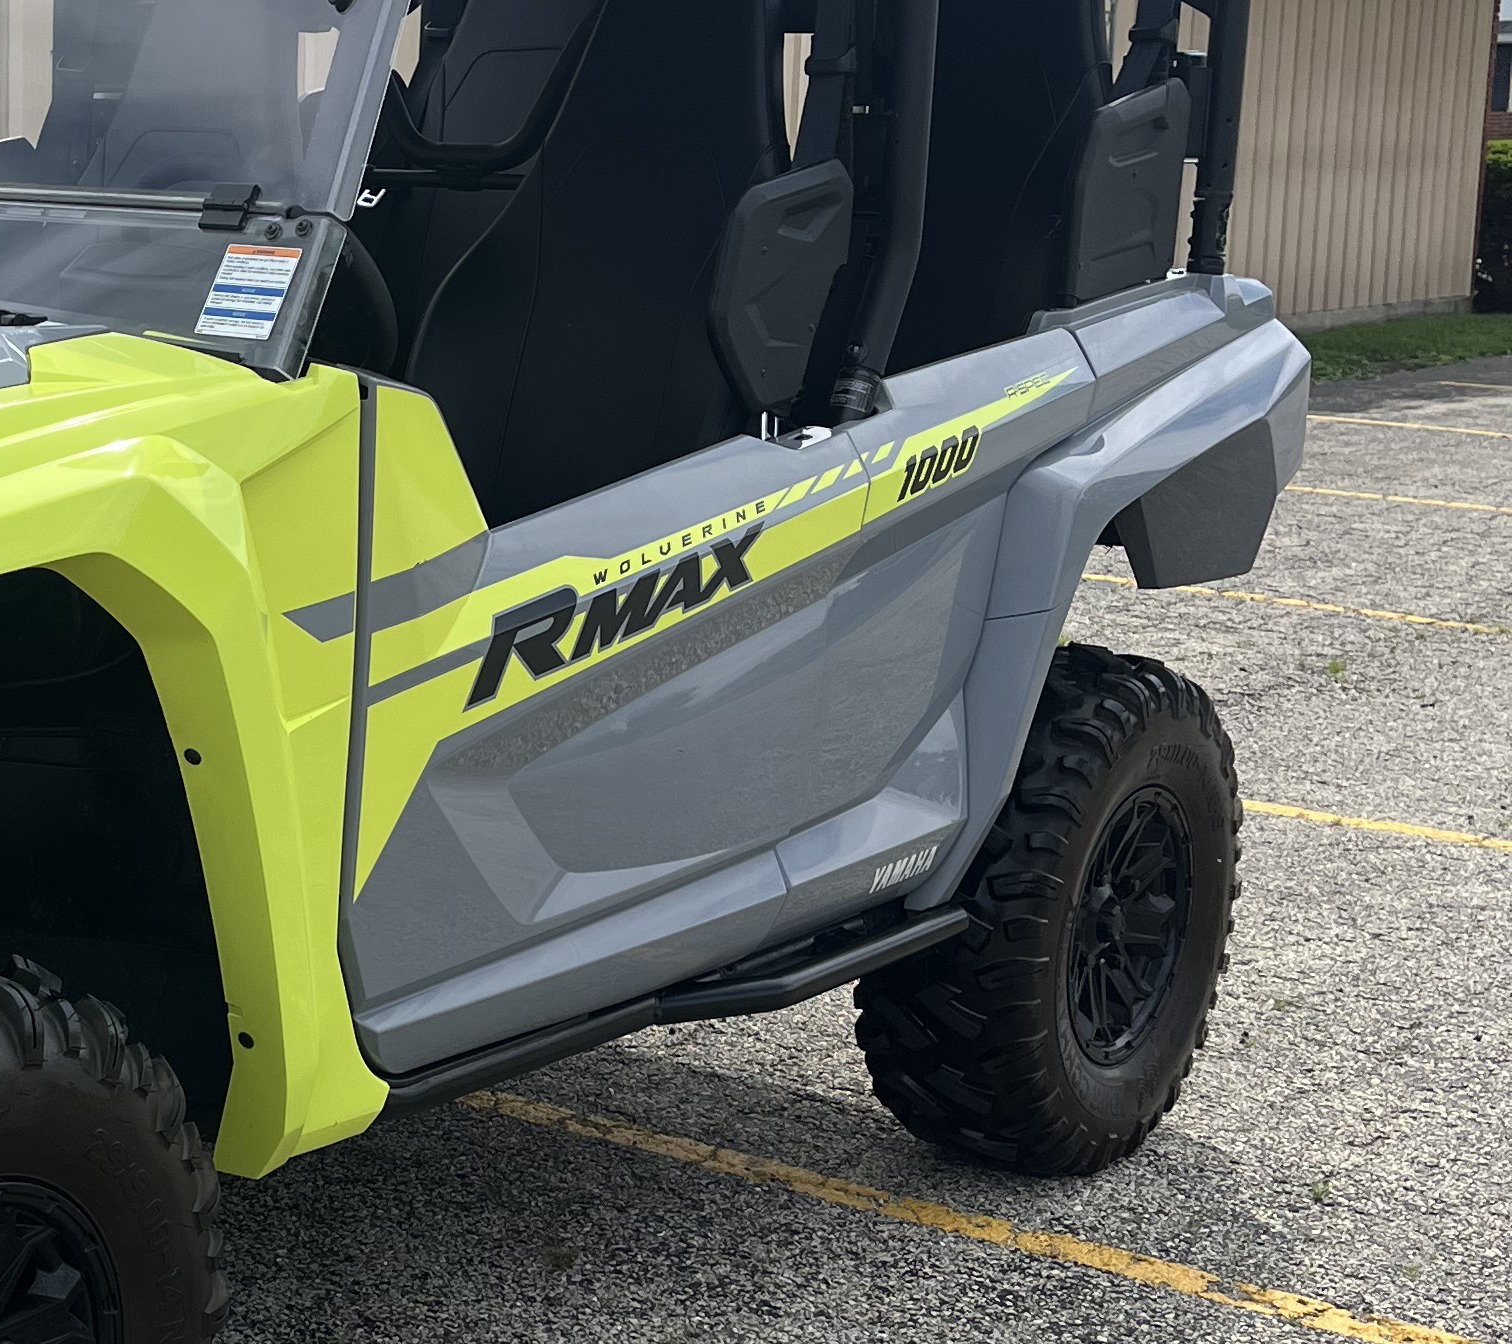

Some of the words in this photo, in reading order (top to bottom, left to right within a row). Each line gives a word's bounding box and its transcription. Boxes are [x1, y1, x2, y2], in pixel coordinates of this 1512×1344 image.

[896, 424, 980, 503] 1000
[593, 500, 766, 586] WOLVERINE
[461, 520, 766, 714] RMAX
[868, 844, 938, 894] YAMAHA
